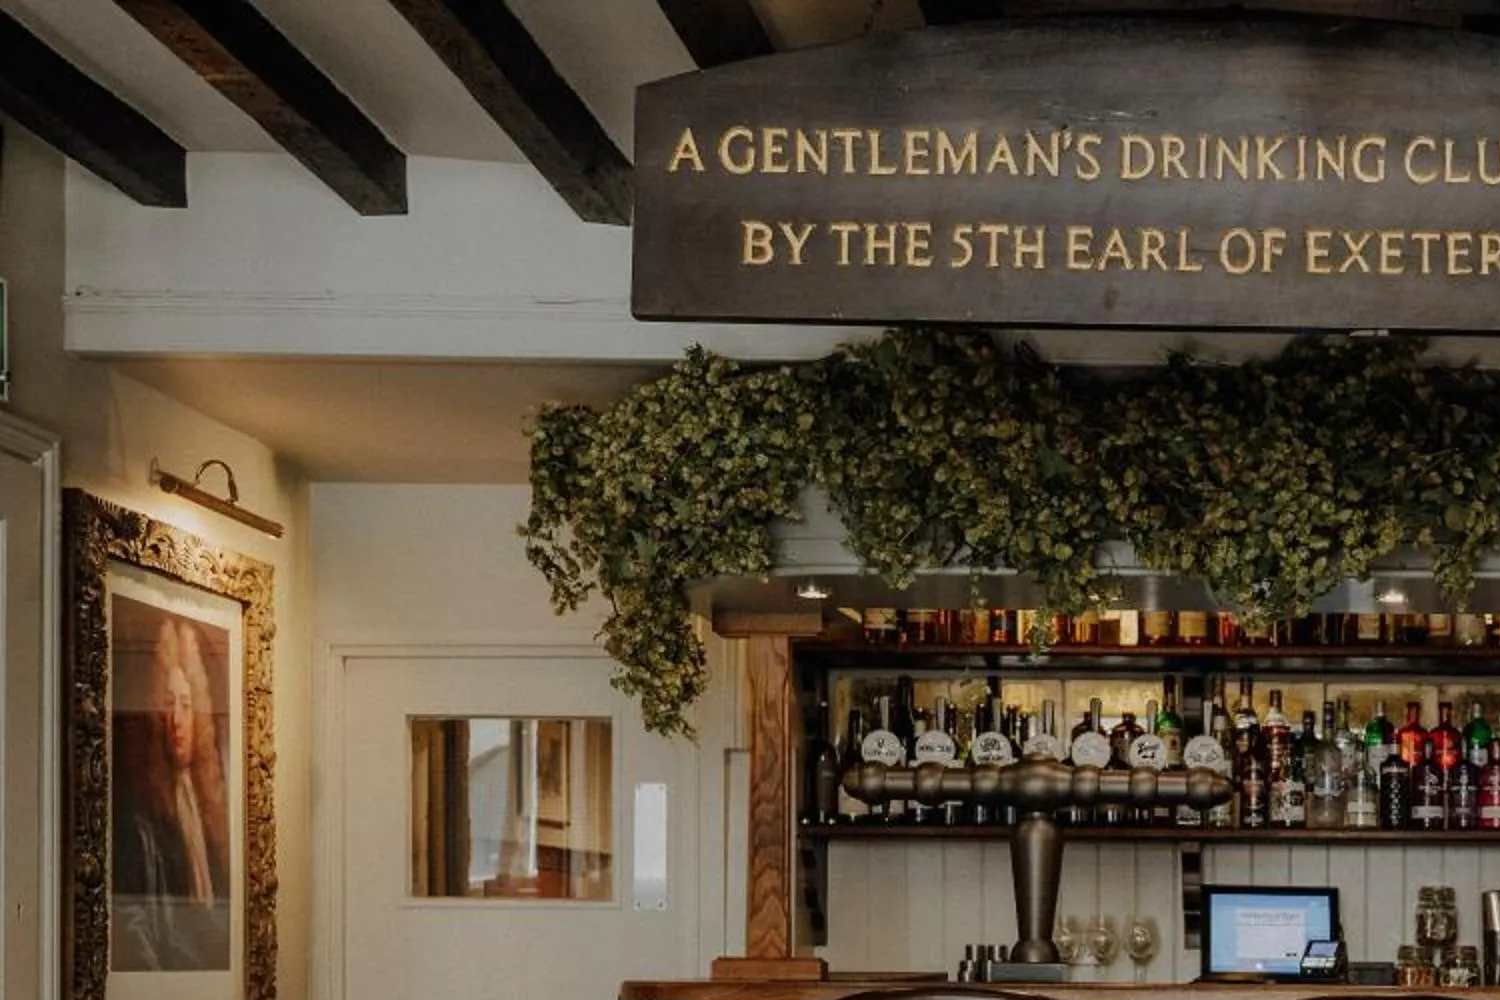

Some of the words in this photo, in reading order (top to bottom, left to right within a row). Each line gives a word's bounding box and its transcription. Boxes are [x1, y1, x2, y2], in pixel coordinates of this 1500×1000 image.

[668, 128, 705, 173] A
[717, 126, 1102, 182] GENTLEMAN'S
[1119, 133, 1387, 184] DRINKING
[741, 220, 815, 265] BY
[829, 221, 933, 267] THE
[950, 222, 1045, 269] 5TH
[1066, 225, 1203, 272] EARL
[1219, 227, 1287, 275] OF
